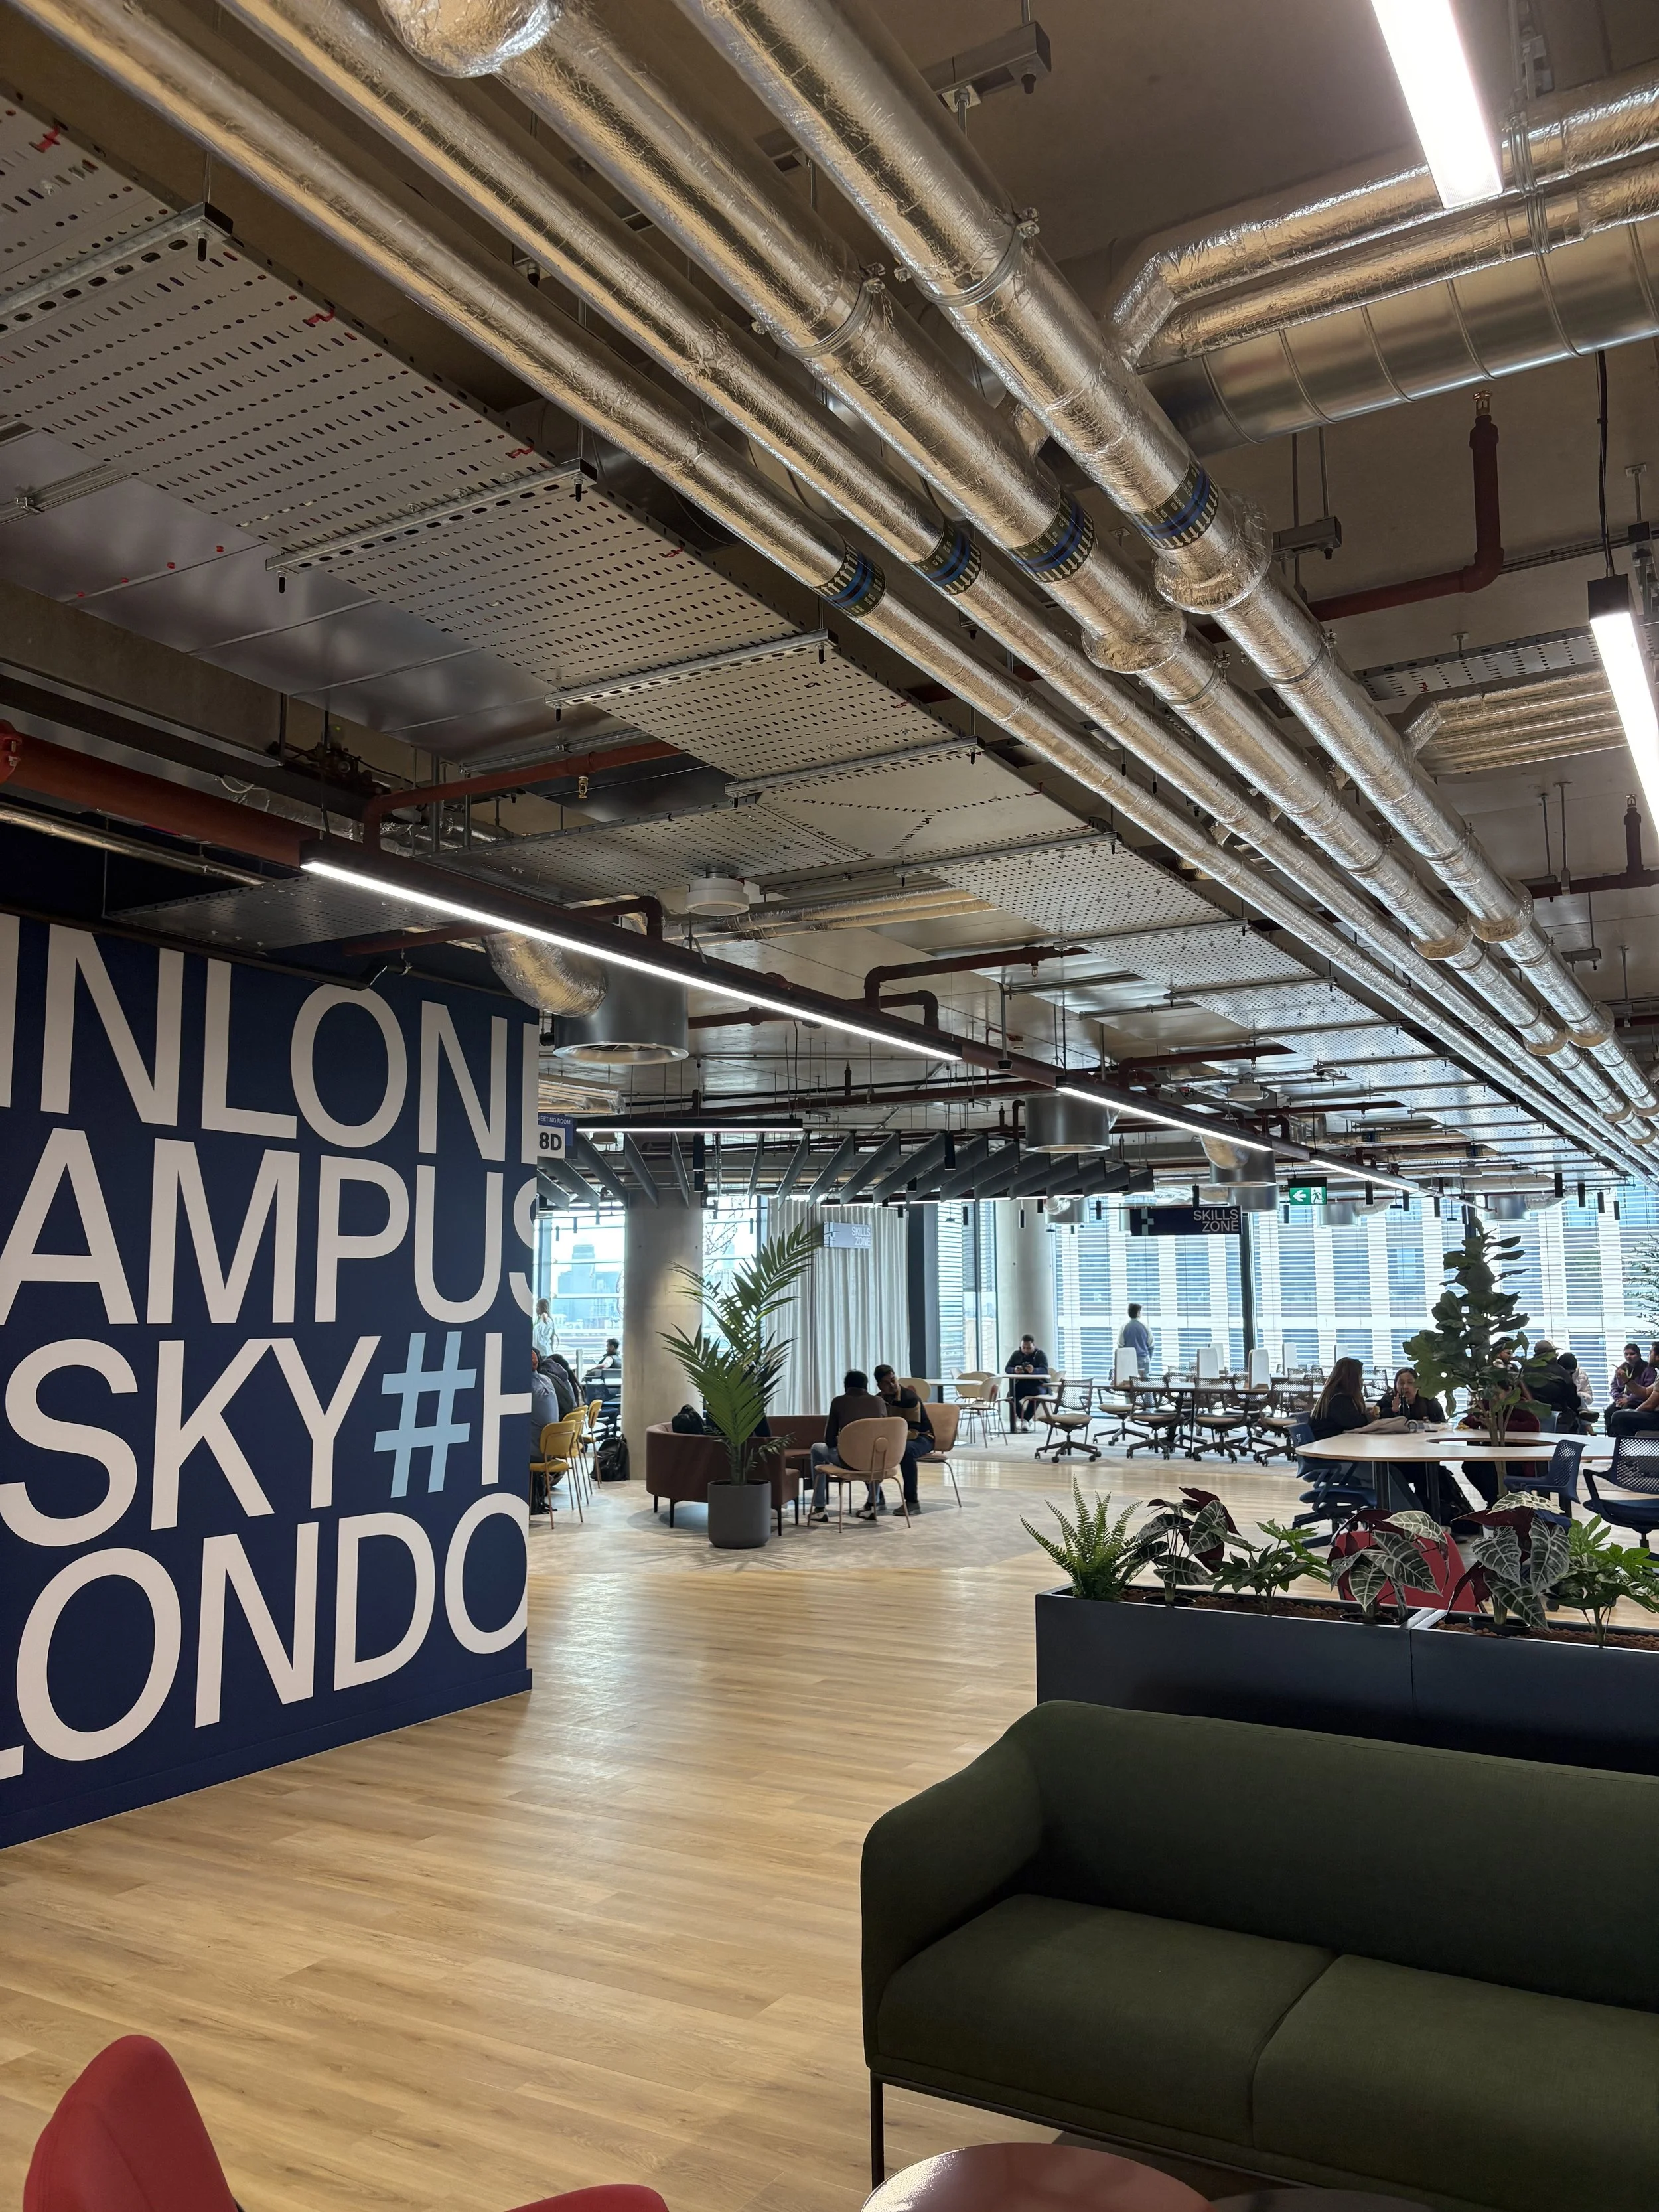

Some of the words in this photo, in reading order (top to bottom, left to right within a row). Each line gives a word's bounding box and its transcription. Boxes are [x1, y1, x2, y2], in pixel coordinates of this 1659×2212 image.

[539, 1132, 562, 1151] 8D
[1193, 1209, 1238, 1221] SKILLS
[851, 1226, 871, 1237] SKILLS
[1202, 1220, 1239, 1232] ZONE
[855, 1236, 871, 1246] ZONE
[0, 1492, 530, 1781] ONDO
